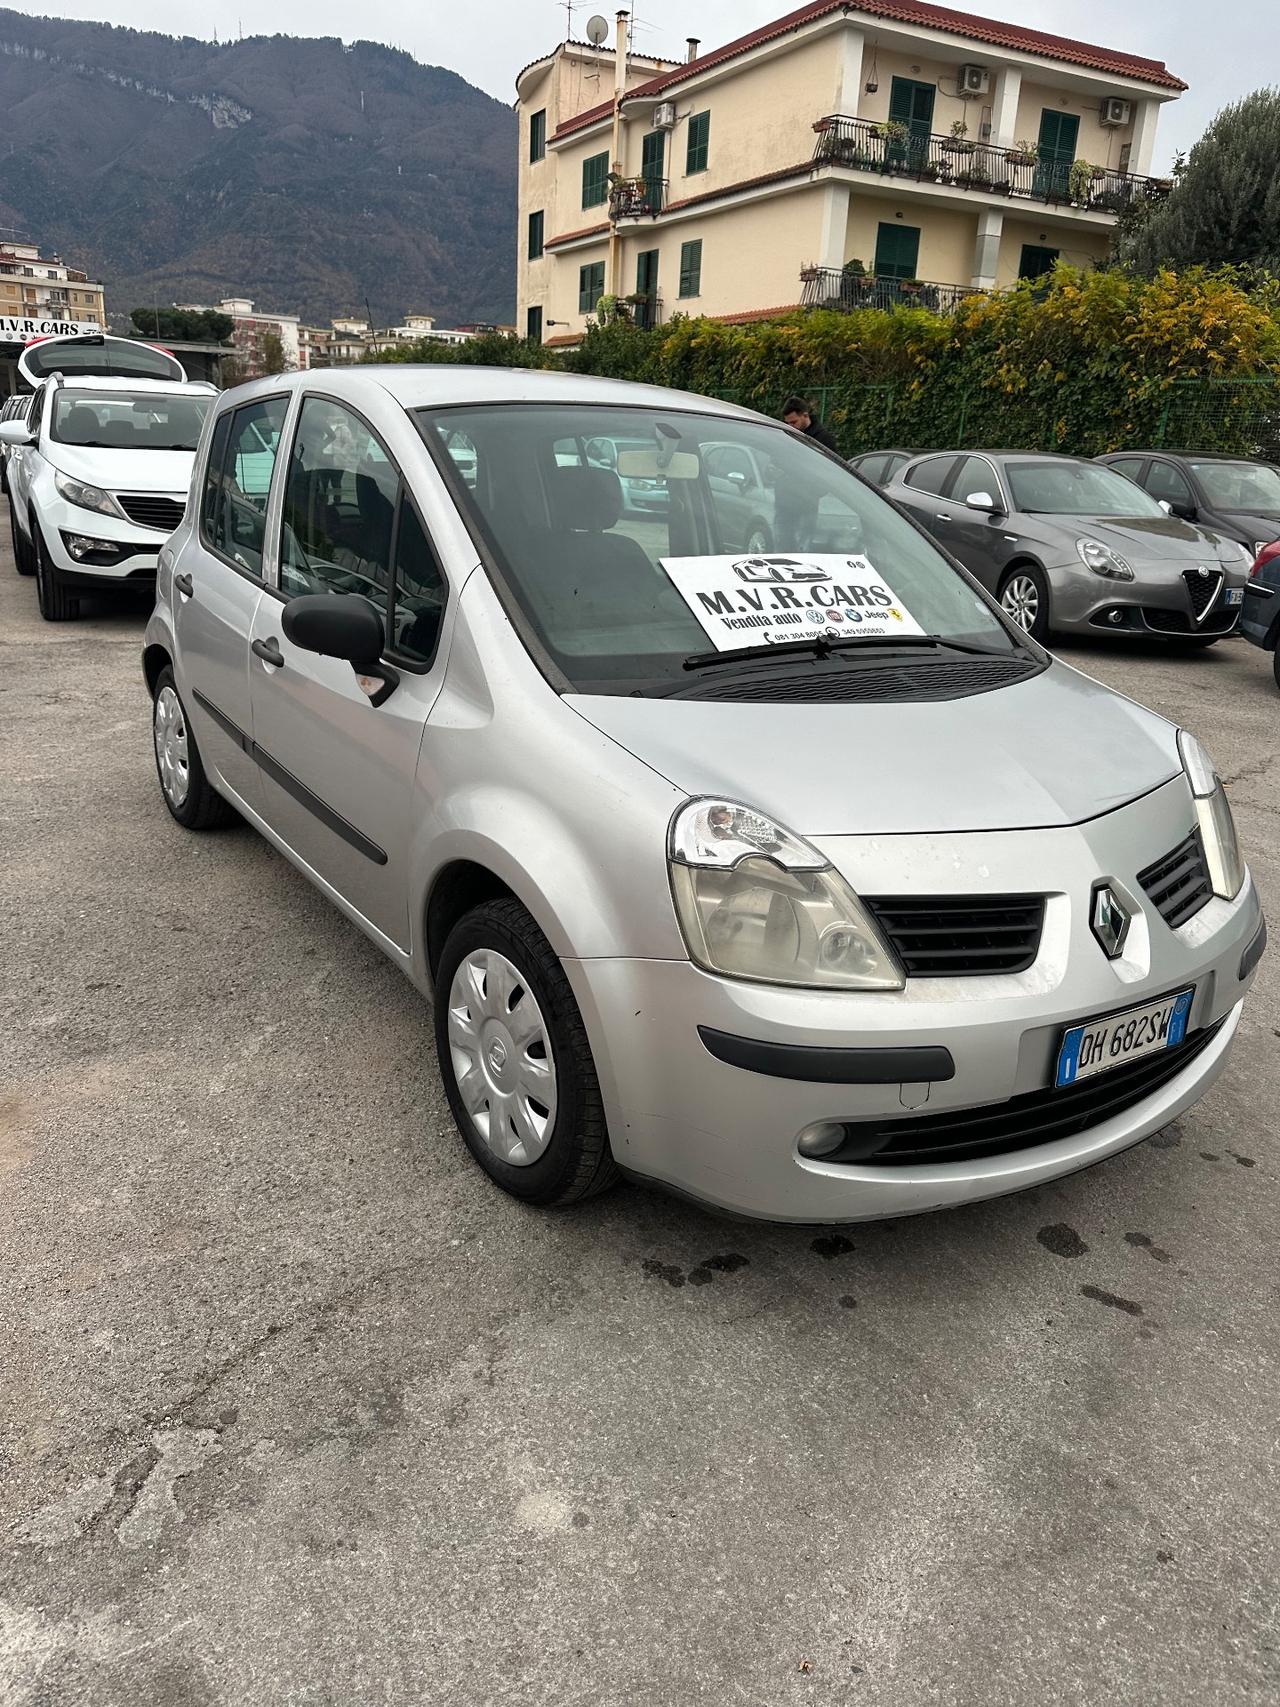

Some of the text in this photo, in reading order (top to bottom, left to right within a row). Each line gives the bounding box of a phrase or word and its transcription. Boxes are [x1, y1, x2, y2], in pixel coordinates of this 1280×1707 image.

[720, 611, 803, 631] Vendita auto
[864, 610, 889, 620] Jeep
[1078, 1029, 1108, 1069] DH
